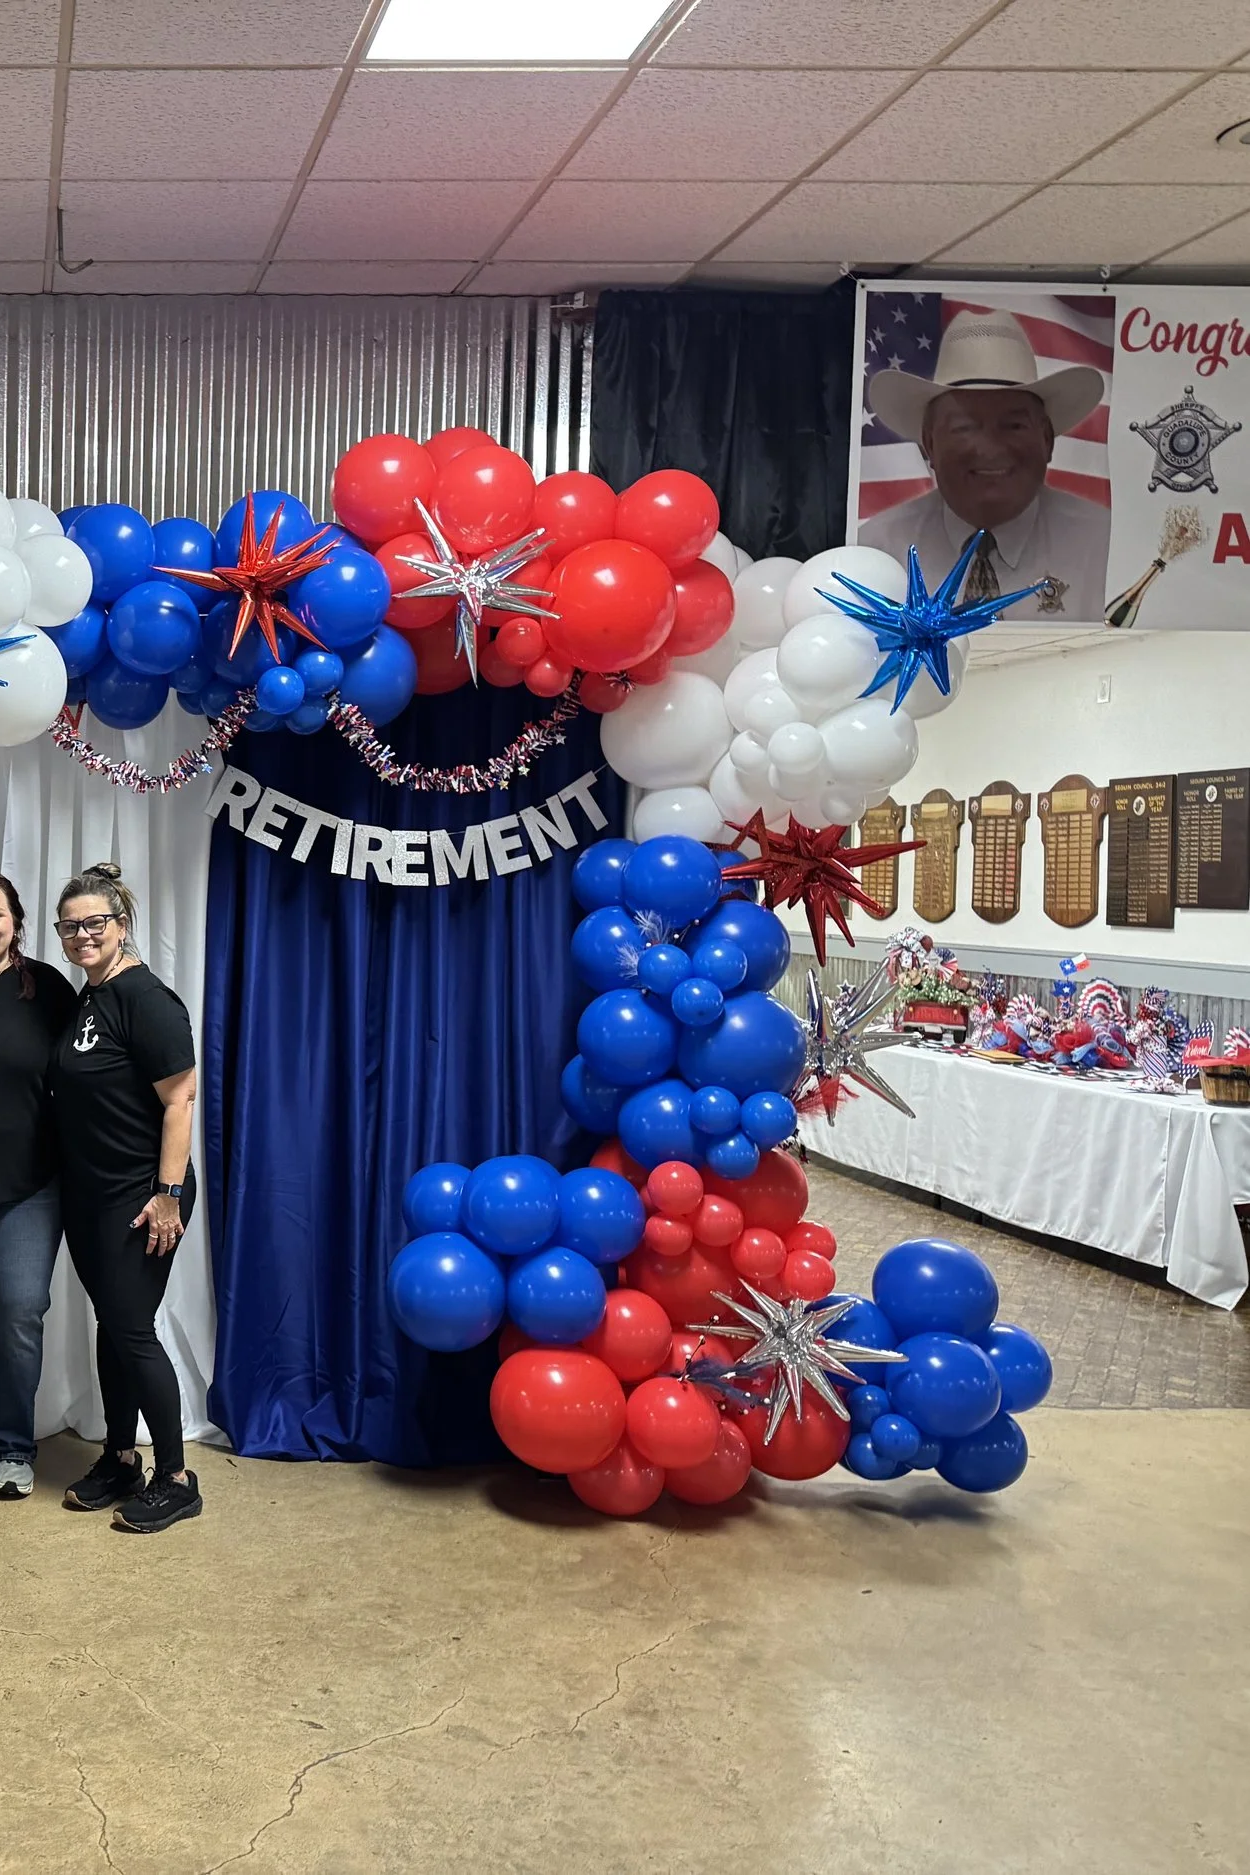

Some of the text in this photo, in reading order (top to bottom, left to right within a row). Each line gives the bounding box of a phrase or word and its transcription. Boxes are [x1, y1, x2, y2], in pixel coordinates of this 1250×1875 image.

[1120, 307, 1250, 377] Congr
[1163, 420, 1207, 438] GUADALUPE
[1165, 452, 1200, 465] COUNTY
[204, 764, 609, 887] RETIREMENT
